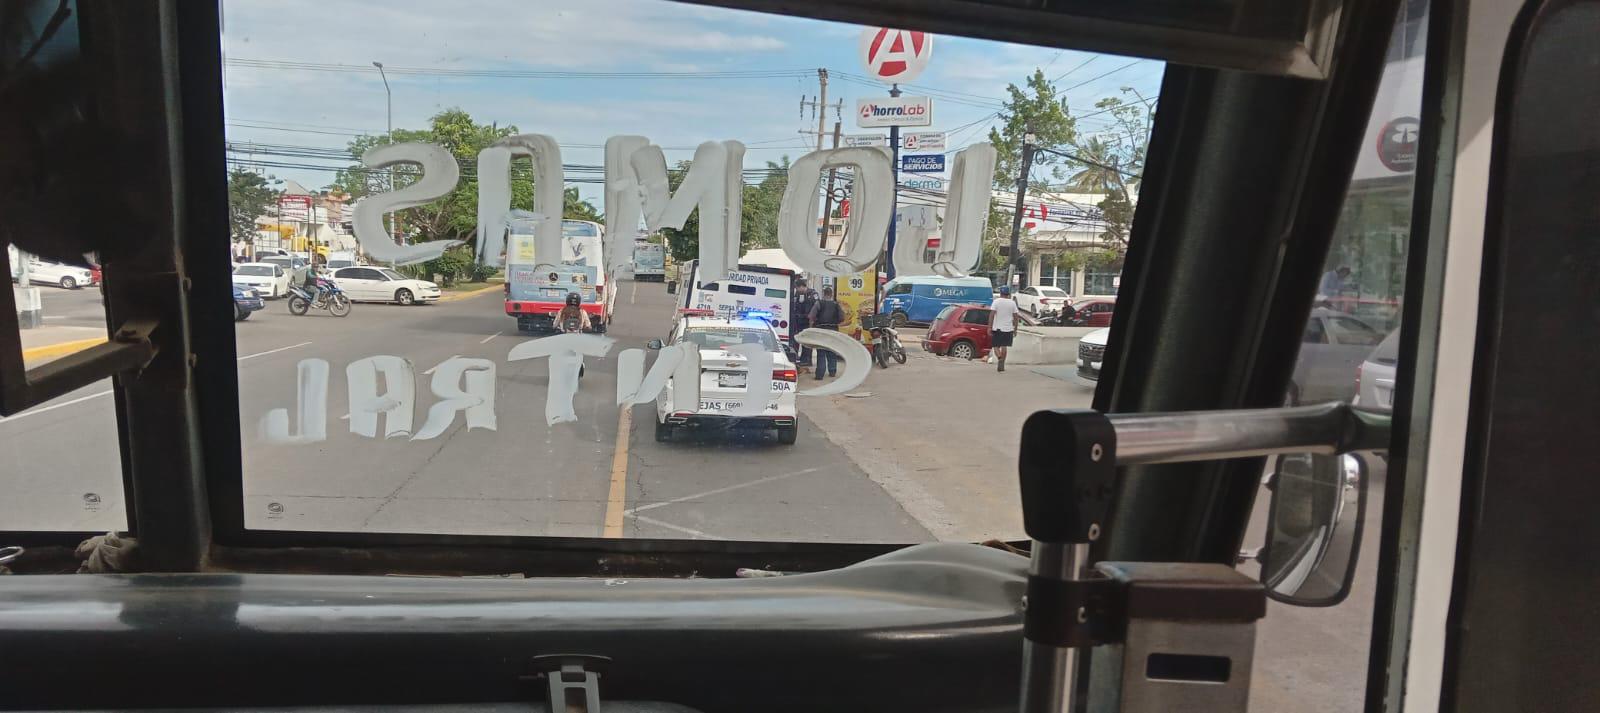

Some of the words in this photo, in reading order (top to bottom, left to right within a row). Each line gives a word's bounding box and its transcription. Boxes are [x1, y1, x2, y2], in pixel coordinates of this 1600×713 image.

[860, 103, 925, 118] AhorroLab
[903, 163, 943, 171] SERVICIOS
[904, 178, 942, 189] derma
[747, 274, 769, 285] PRIVADA
[700, 401, 721, 410] EJAS
